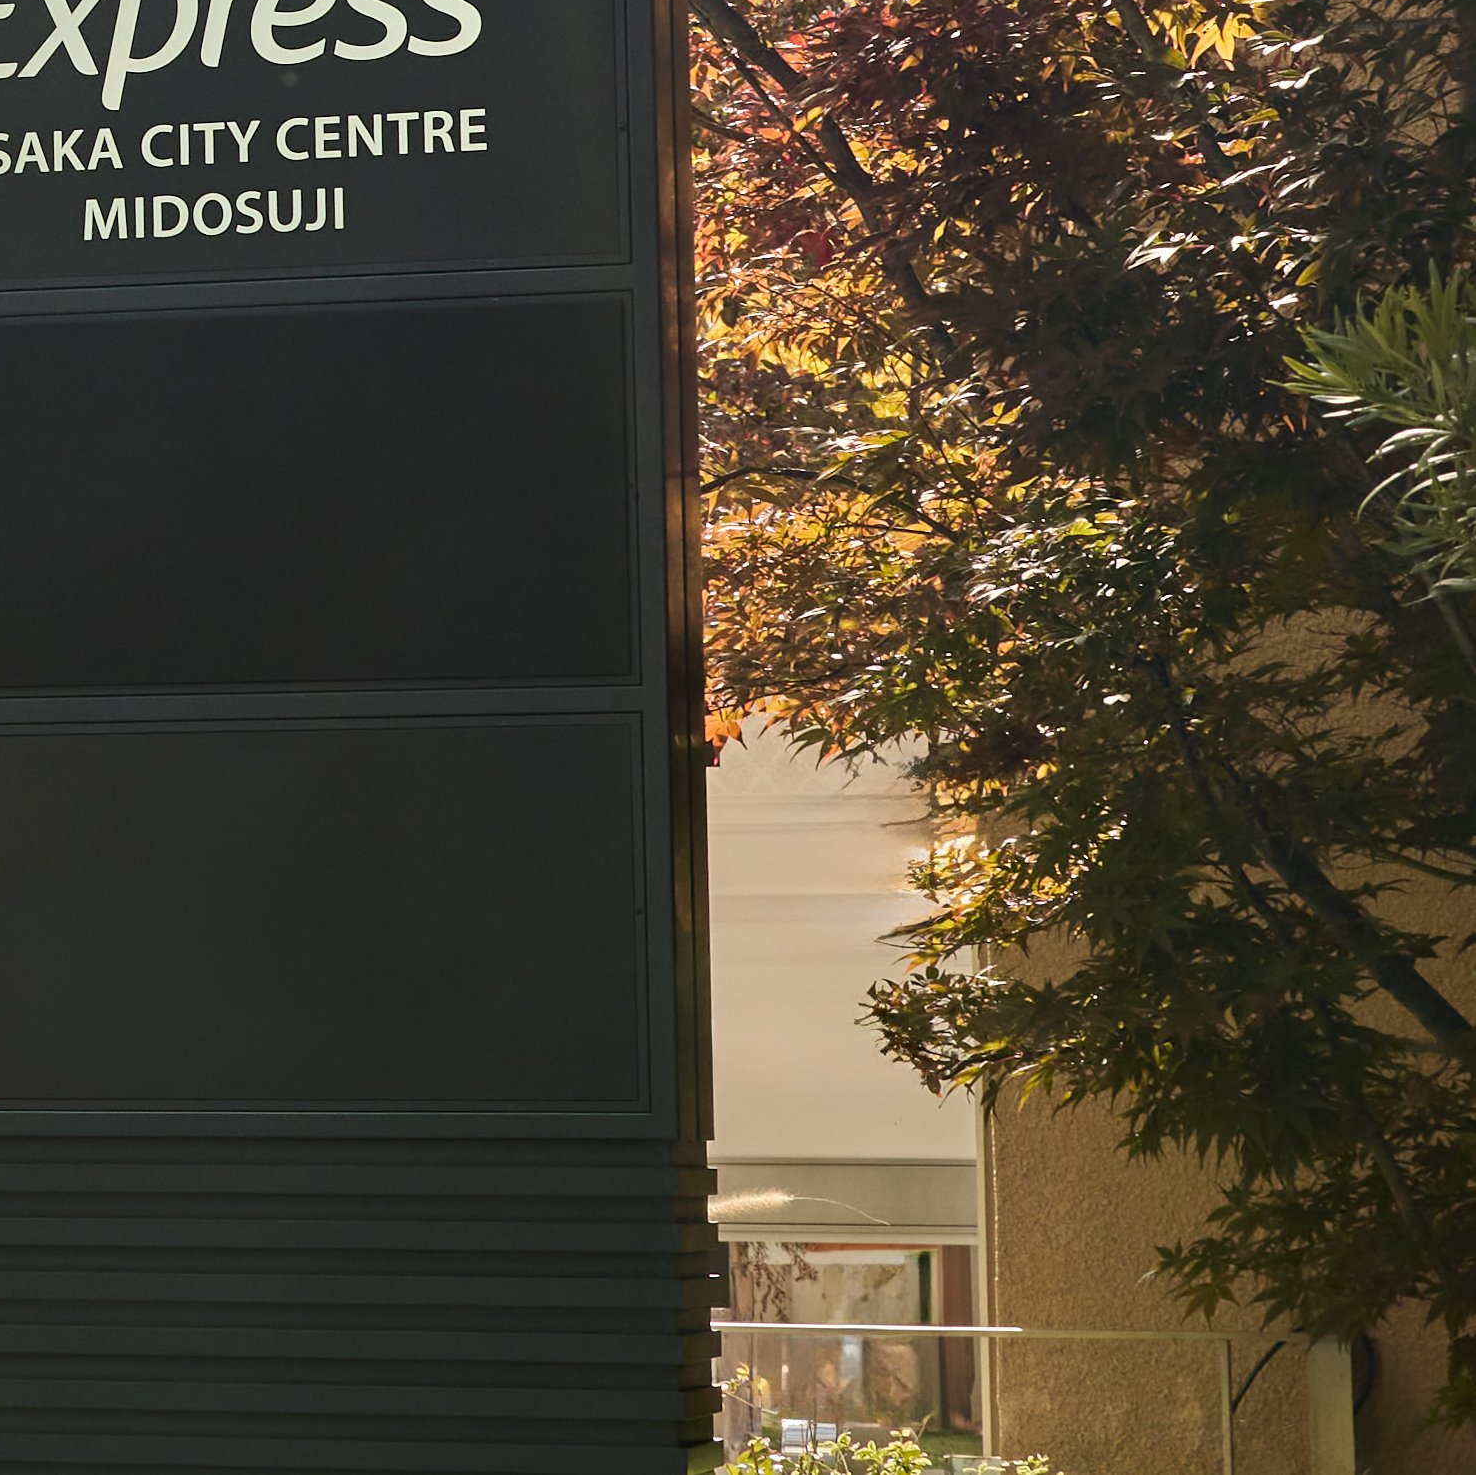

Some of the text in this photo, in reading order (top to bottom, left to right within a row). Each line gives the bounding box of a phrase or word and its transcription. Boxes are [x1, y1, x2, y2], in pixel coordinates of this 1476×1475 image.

[142, 118, 260, 167] CITY
[277, 109, 487, 158] CENTRE
[84, 188, 344, 240] MIDOSUJI
